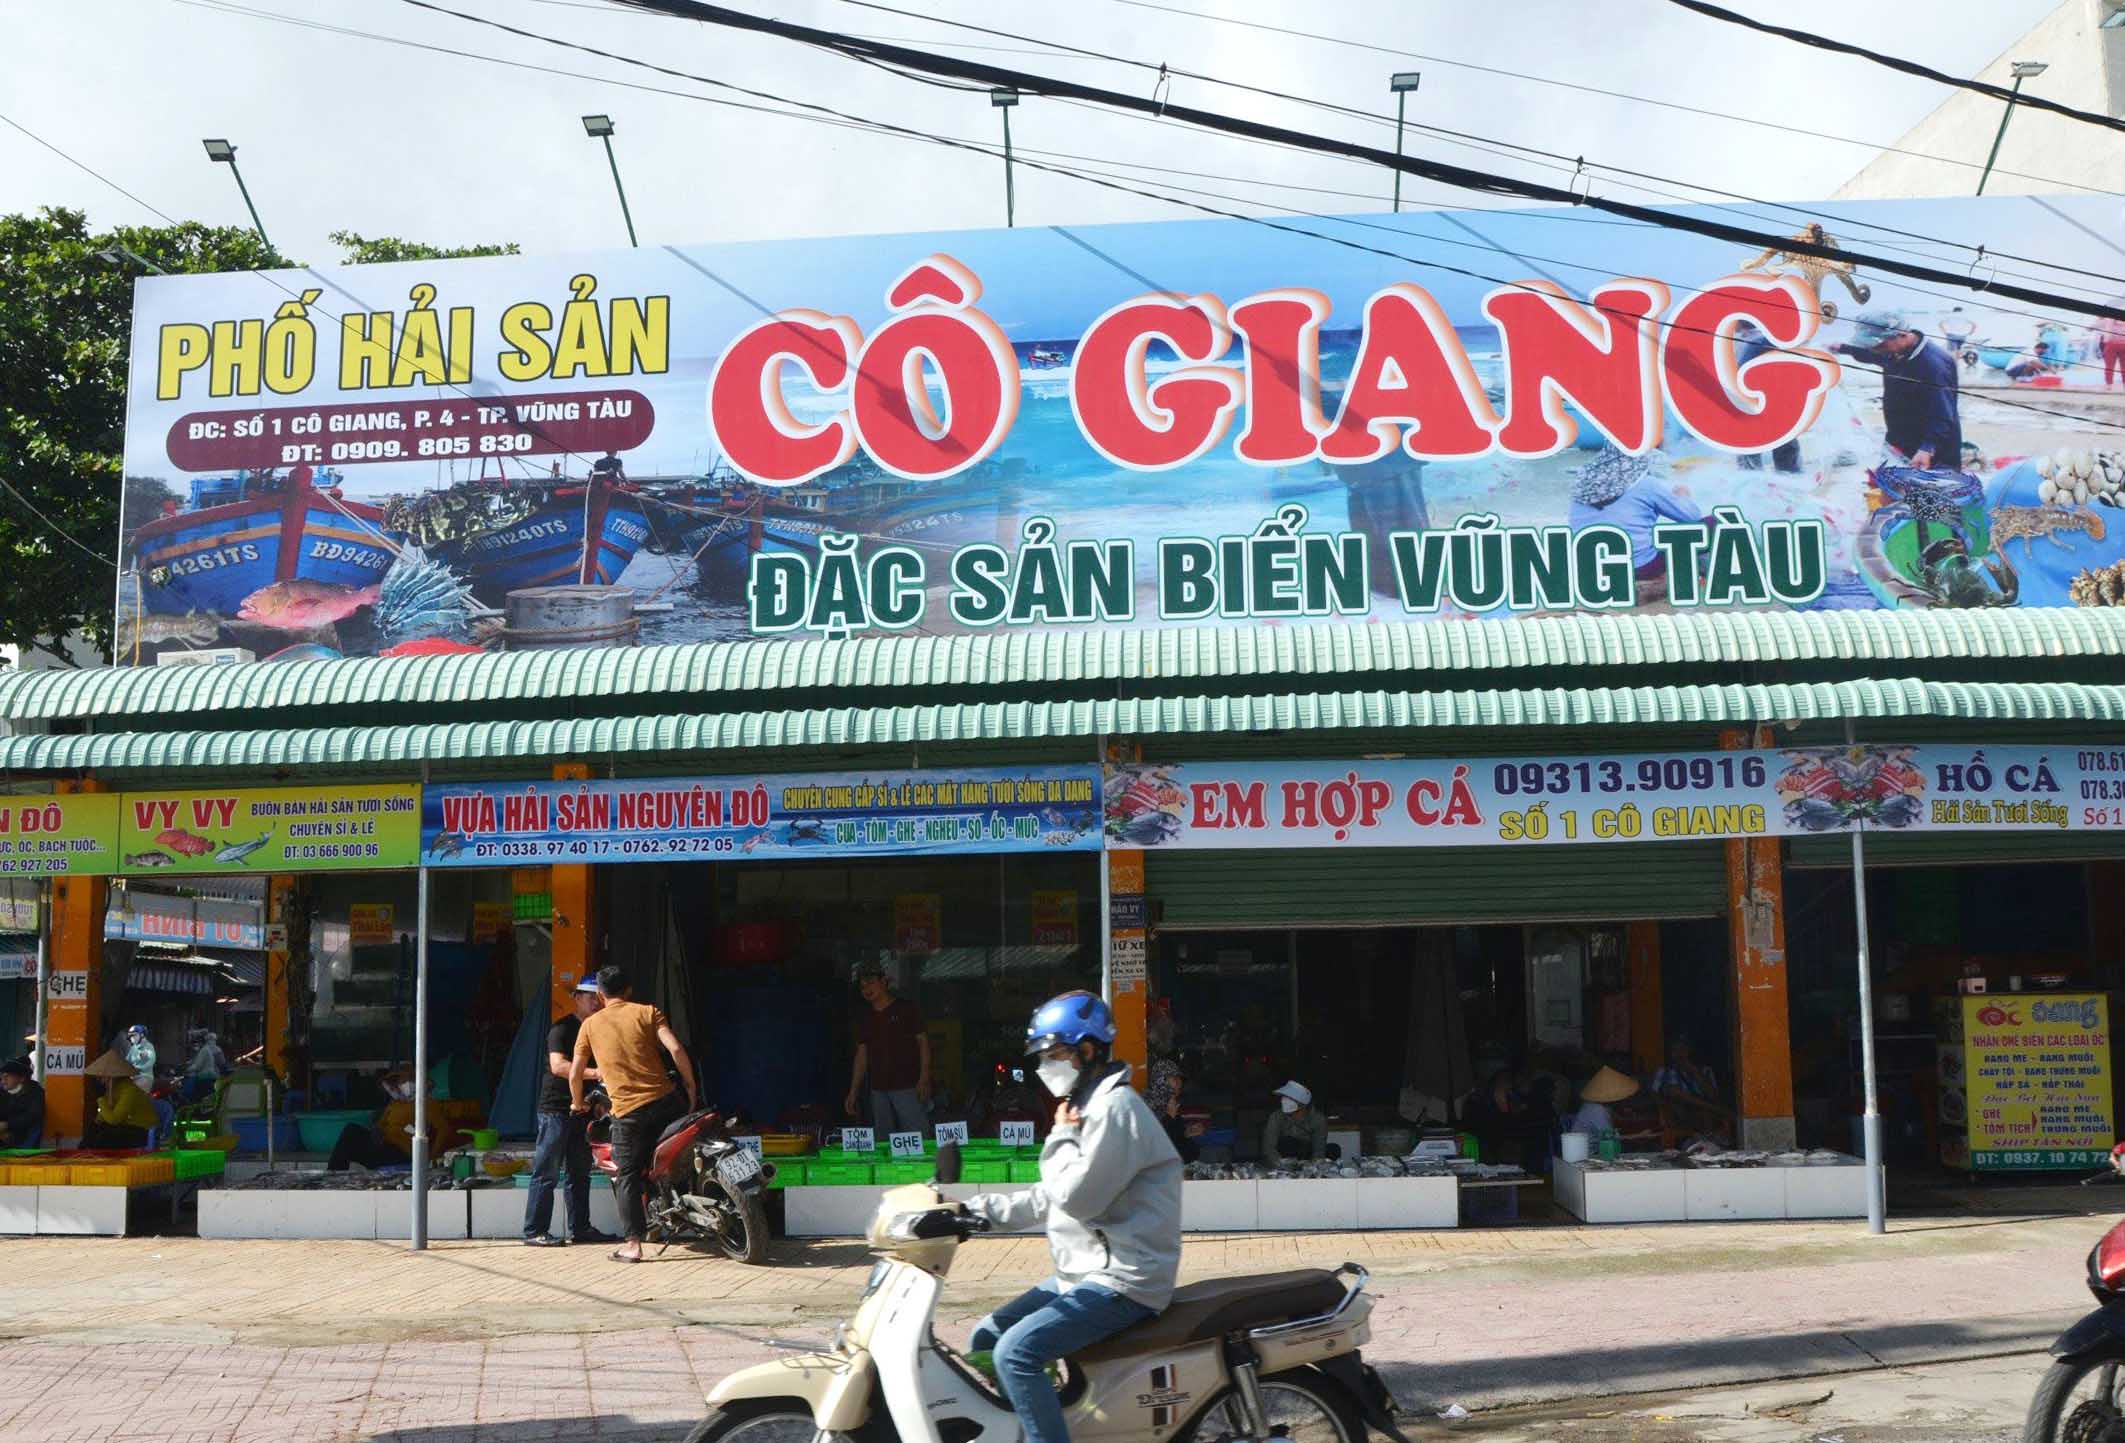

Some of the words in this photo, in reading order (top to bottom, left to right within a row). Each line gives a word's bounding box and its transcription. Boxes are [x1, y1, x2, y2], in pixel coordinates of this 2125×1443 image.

[157, 288, 323, 400] PHỐ
[338, 283, 474, 390] HẢI
[498, 274, 670, 381] SẢN
[706, 252, 1021, 487] CÔ
[1070, 272, 1841, 472] GIANG
[188, 421, 227, 440] ĐC:
[233, 412, 264, 438] SỐ
[271, 418, 282, 435] 1
[291, 412, 322, 434] CÔ
[329, 411, 407, 434] GIANG,
[414, 411, 432, 429] P.
[439, 410, 454, 426] 4
[478, 406, 507, 424] TP.
[516, 400, 581, 422] VŨNG
[587, 397, 632, 418] TÀU
[281, 445, 322, 462] ĐT:
[331, 441, 408, 460] 0909.
[418, 437, 470, 456] 805
[479, 433, 533, 453] 830
[749, 534, 925, 640] ĐẶC
[950, 516, 1135, 626] SẢN
[1158, 503, 1368, 620] BIỂN
[1389, 511, 1636, 616] VŨNG
[1656, 506, 1826, 606] TÀU
[1494, 757, 1766, 795] 09313.90916
[1936, 750, 1993, 792] HỒ
[2005, 756, 2061, 792] CÁ
[825, 785, 852, 809] CUNG
[1189, 780, 1269, 830] EM
[1281, 771, 1393, 841] HỢP
[1406, 765, 1485, 828] CÁ
[2081, 779, 2125, 800] 078.3
[20, 801, 62, 833] ĐÔ
[134, 800, 178, 831] VY
[193, 798, 240, 830] VY
[251, 801, 281, 816] BUÔN
[443, 791, 496, 840] VỰA
[504, 786, 549, 832] HẢI
[557, 785, 609, 831] SẢN
[619, 785, 724, 829] NGUYÊN
[731, 784, 769, 827] ĐÔ
[1499, 801, 1549, 840] SỐ
[1559, 810, 1577, 839] 1
[1592, 803, 1642, 838] CÔ
[1653, 803, 1766, 837] GIANG
[2083, 805, 2110, 825] Số
[2113, 806, 2122, 825] 1
[289, 820, 332, 837] CHUYÊN
[836, 821, 856, 844] CUA
[865, 817, 887, 843] TÔM
[303, 845, 316, 858] 03
[320, 845, 339, 857] 666
[343, 844, 362, 857] 900
[365, 843, 378, 856] 96
[477, 842, 497, 856] ĐT:
[502, 841, 542, 856] 0338.
[547, 842, 564, 855] 97
[569, 841, 587, 855] 40
[593, 841, 608, 854] 17
[623, 839, 663, 854] 0762.
[669, 839, 686, 853] 92
[691, 838, 708, 852] 72
[714, 838, 732, 852] 05
[20, 859, 41, 871] 927
[46, 858, 67, 871] 205
[46, 1050, 62, 1069] CÁ
[892, 1135, 920, 1150] GHẸ
[1003, 1125, 1015, 1139] CÁ
[2004, 1153, 2045, 1164] 0937.
